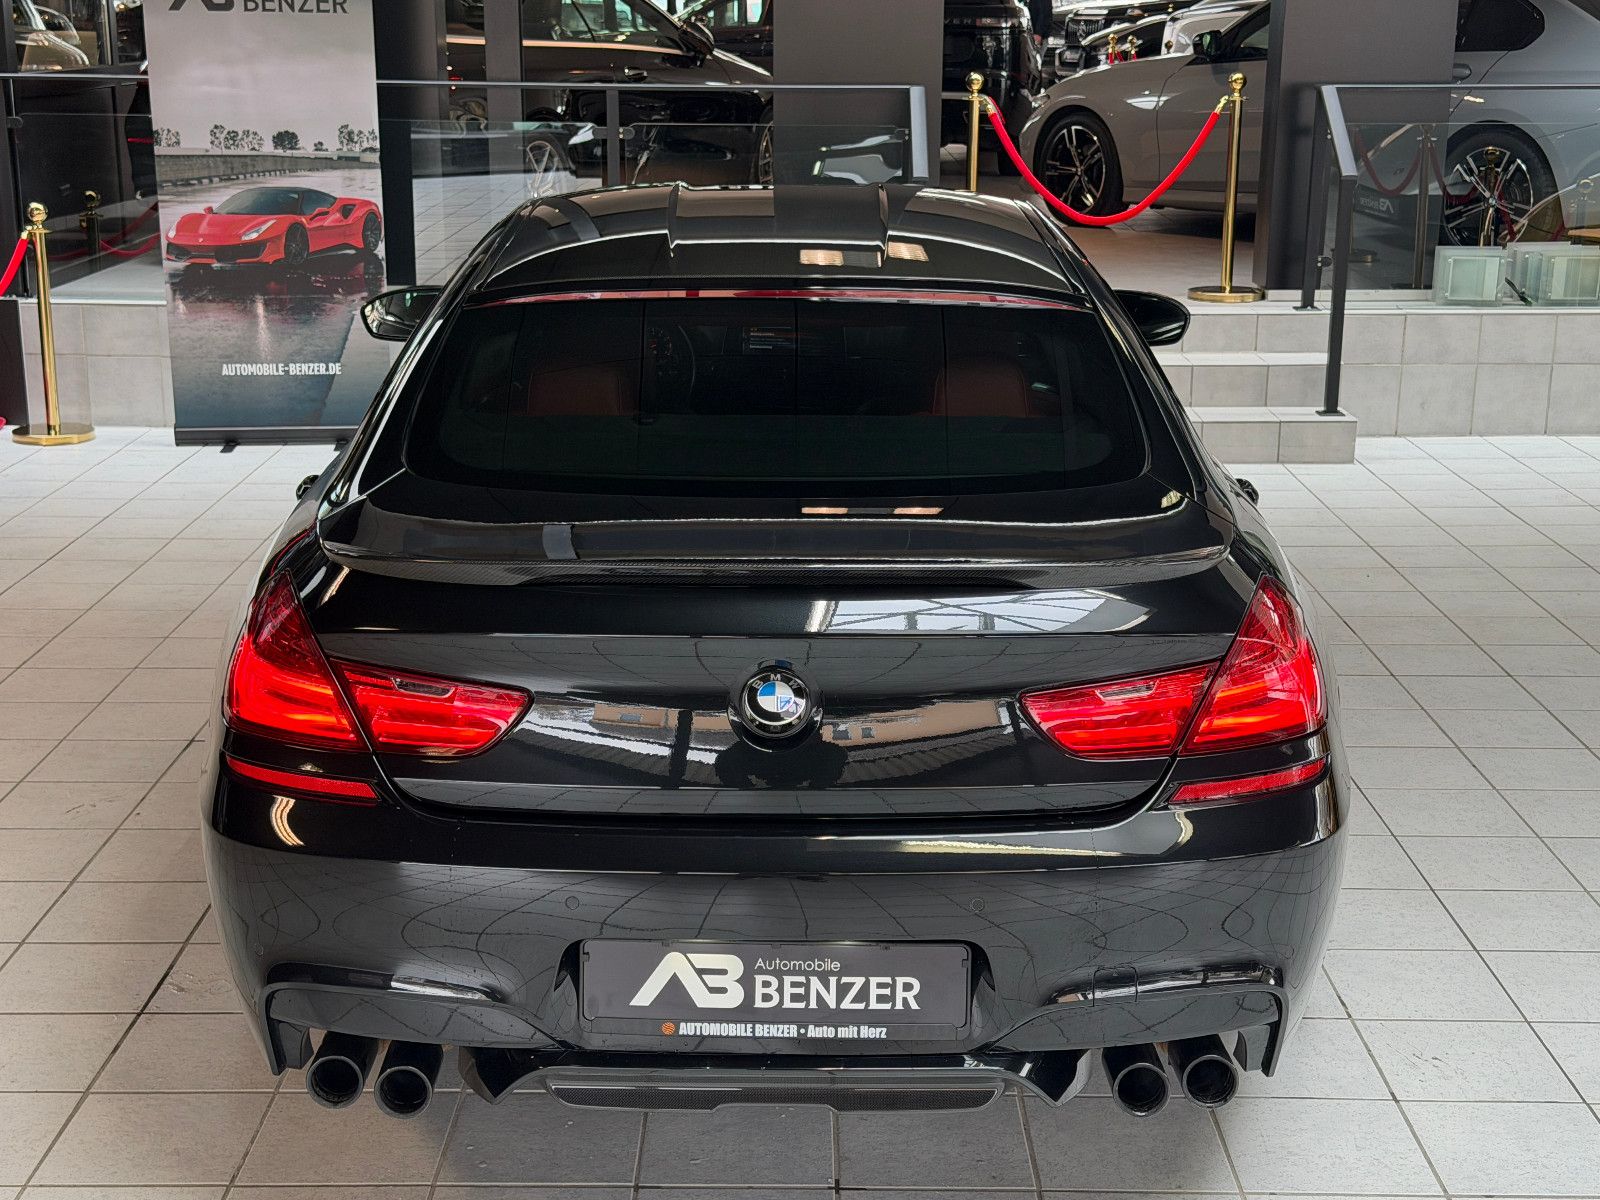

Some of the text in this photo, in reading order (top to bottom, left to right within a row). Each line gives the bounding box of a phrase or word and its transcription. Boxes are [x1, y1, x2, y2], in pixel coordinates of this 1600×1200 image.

[222, 362, 342, 376] AUTOMOBILE-BENZER.DE
[751, 673, 801, 690] BMW
[754, 957, 841, 972] Automobile
[629, 951, 745, 1009] AB
[753, 974, 921, 1010] BENZER
[678, 1022, 887, 1039] AUTOMOBILE BENZER Auto mit Herz
